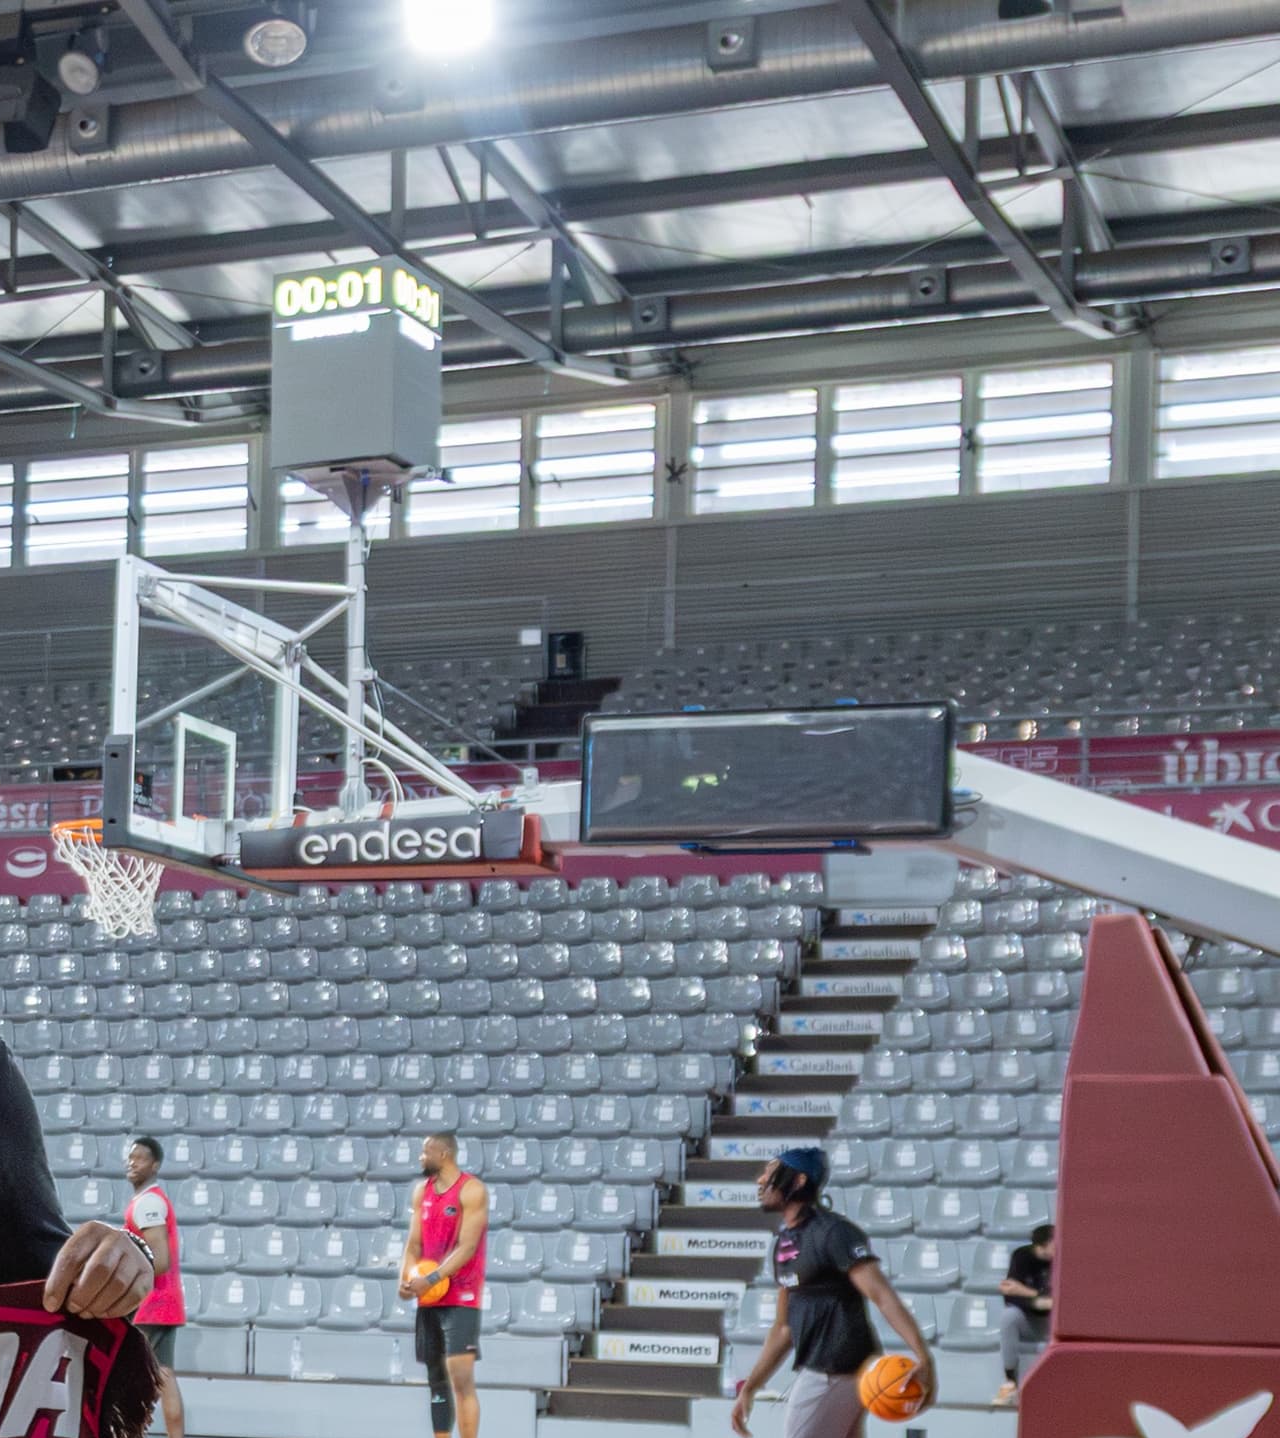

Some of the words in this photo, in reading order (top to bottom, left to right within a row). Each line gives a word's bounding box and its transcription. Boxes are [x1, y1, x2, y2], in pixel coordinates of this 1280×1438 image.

[274, 266, 383, 317] 00:01
[298, 819, 482, 866] endesa
[767, 1098, 833, 1112] CaixaBank
[718, 1188, 759, 1201] Caixa
[629, 1342, 712, 1356] McDonald's
